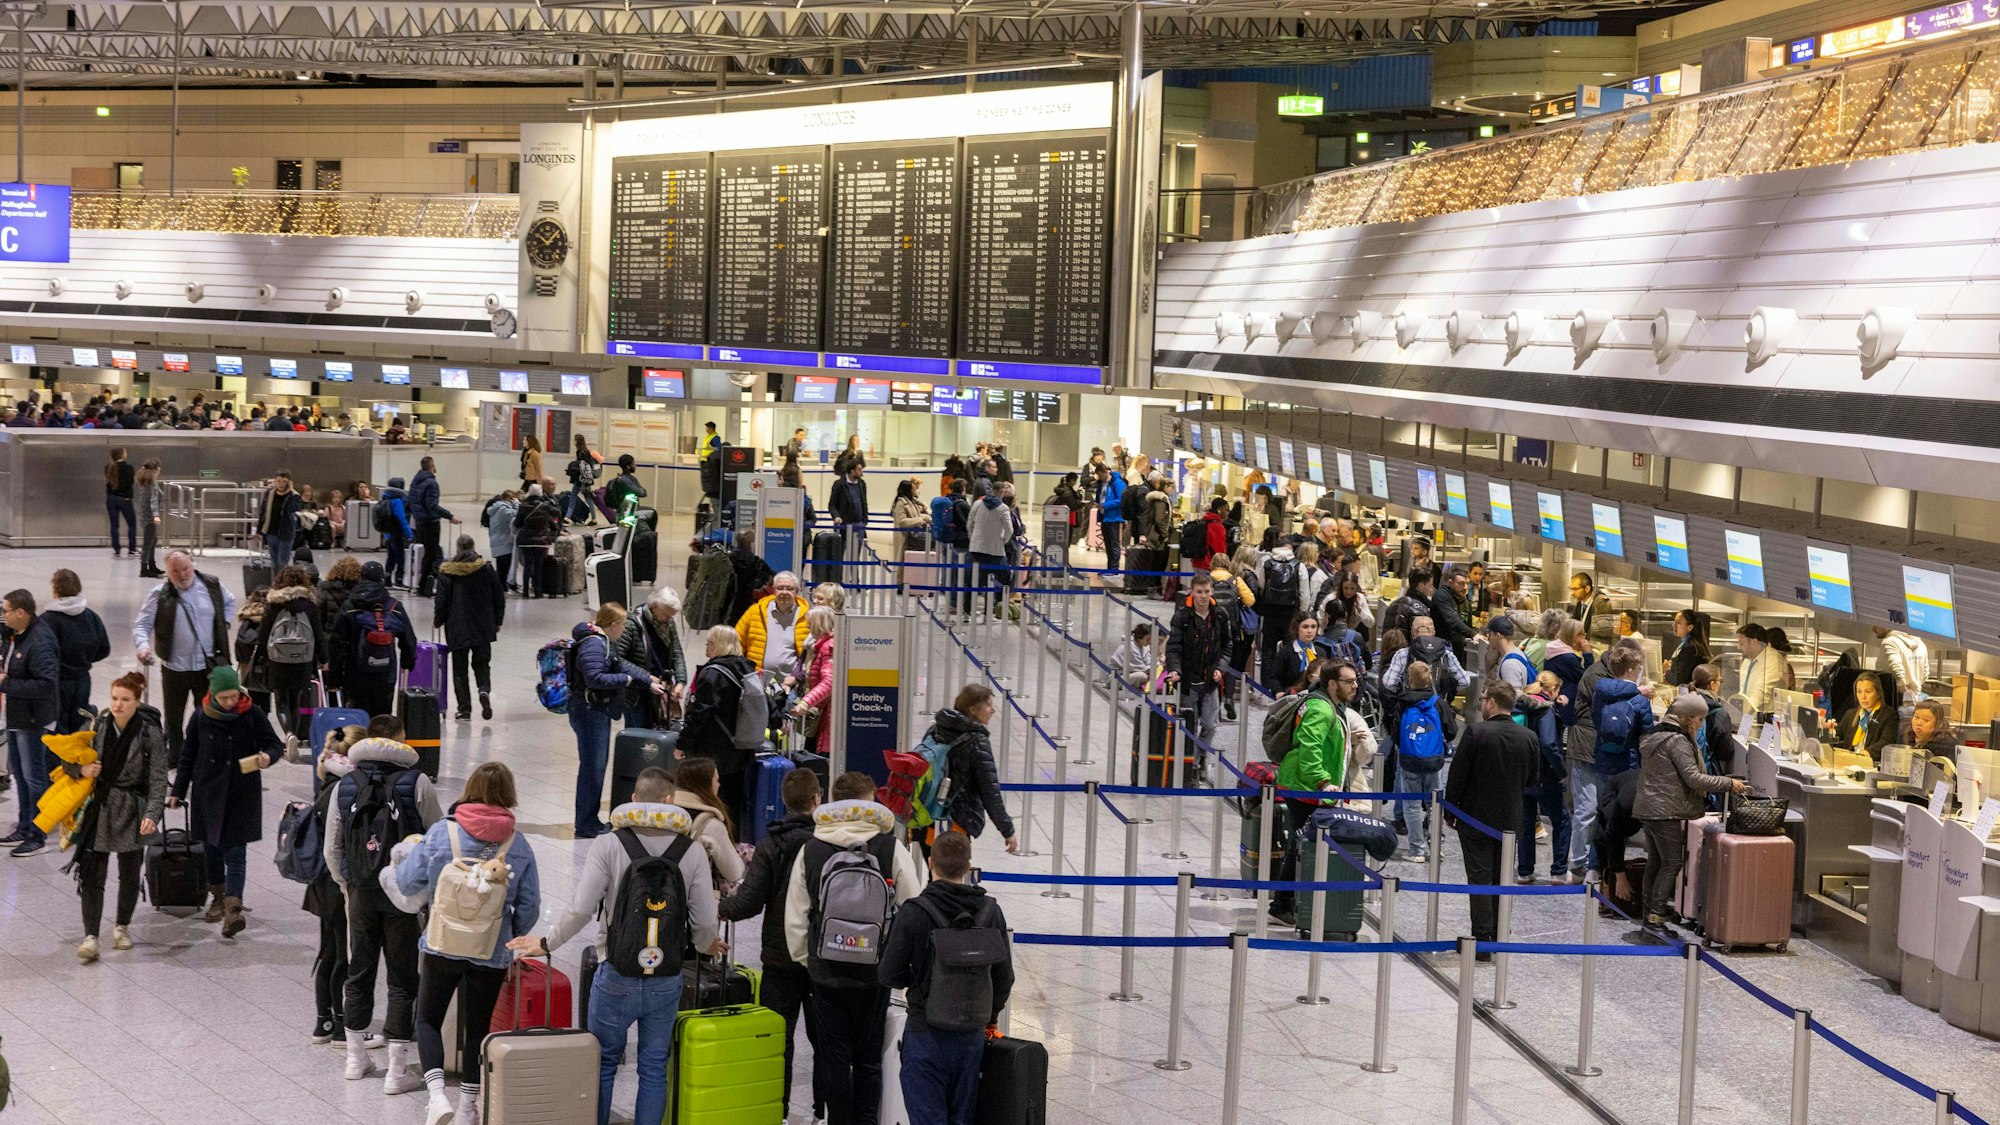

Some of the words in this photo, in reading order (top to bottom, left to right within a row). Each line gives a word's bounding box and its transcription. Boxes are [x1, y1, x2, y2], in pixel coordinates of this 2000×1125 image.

[523, 153, 576, 164] LONGINES
[0, 226, 19, 253] C
[1812, 584, 1826, 594] Check-in
[1909, 608, 1926, 618] Check-in
[854, 636, 893, 645] discover
[852, 693, 886, 704] Priority
[852, 703, 892, 712] Check-in
[1333, 813, 1386, 828] HILFIGER
[1908, 848, 1930, 862] Frankfurt
[1908, 858, 1922, 869] Airport
[1946, 864, 1969, 880] Frankfurt
[1945, 875, 1961, 887] Airport
